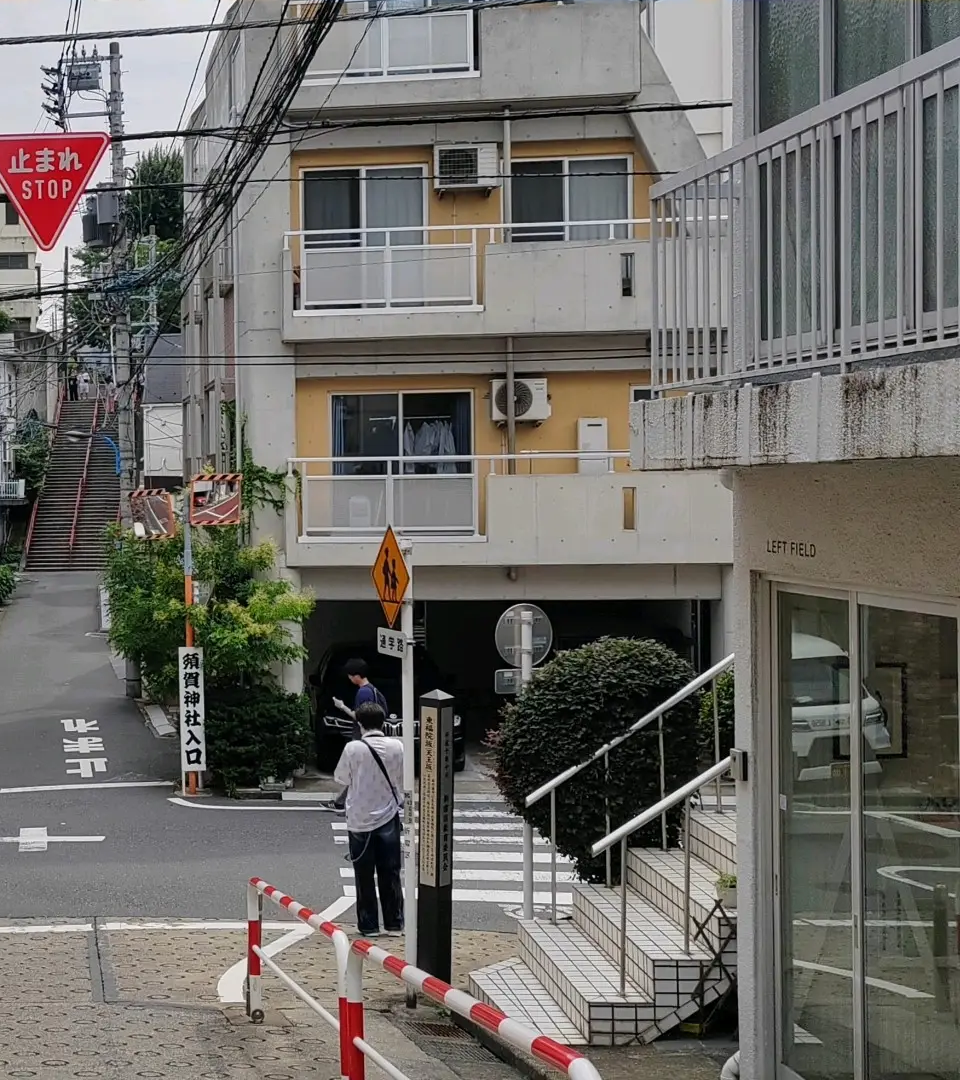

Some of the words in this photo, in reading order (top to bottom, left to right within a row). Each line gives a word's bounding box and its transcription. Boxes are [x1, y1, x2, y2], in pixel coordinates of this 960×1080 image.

[7, 146, 83, 173] 止まれ
[21, 178, 72, 200] STOP
[766, 539, 787, 554] LEFT
[790, 541, 816, 557] FIELD
[182, 652, 202, 766] 須賀神社入口
